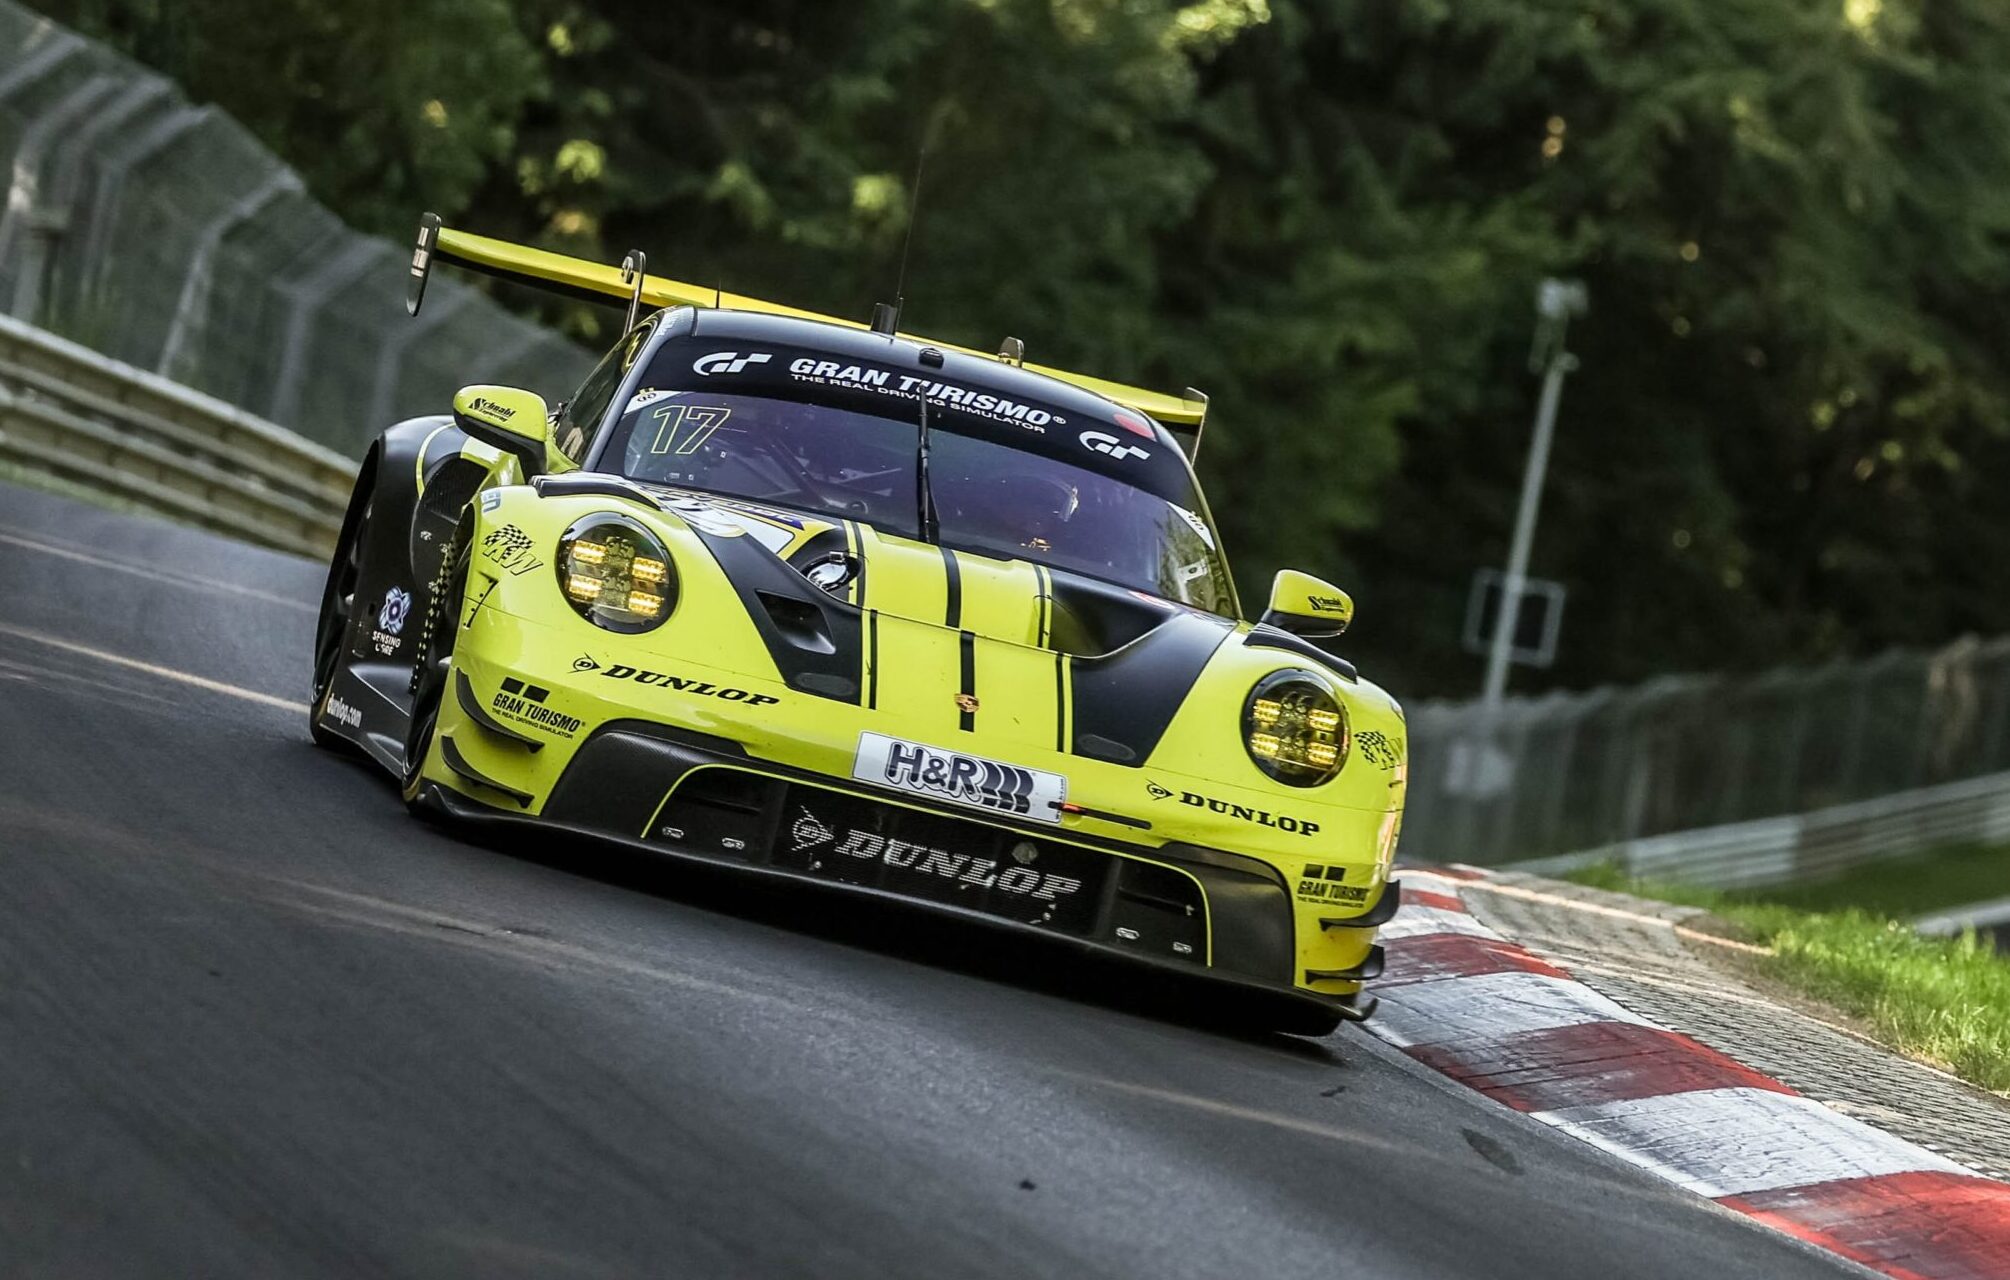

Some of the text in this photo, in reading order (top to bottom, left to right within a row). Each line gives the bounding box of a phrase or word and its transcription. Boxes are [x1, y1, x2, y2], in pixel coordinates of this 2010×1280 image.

[789, 358, 891, 386] GRAN
[790, 373, 825, 384] THE
[829, 378, 874, 392] REAL
[949, 402, 1046, 434] SIMULATOR
[650, 405, 732, 455] 17
[600, 664, 781, 706] DUNLOP
[492, 692, 582, 733] GRAN TURISMO
[886, 742, 983, 800] H&R
[1178, 791, 1320, 837] DUNLOP
[834, 829, 1082, 900] DUNLOP
